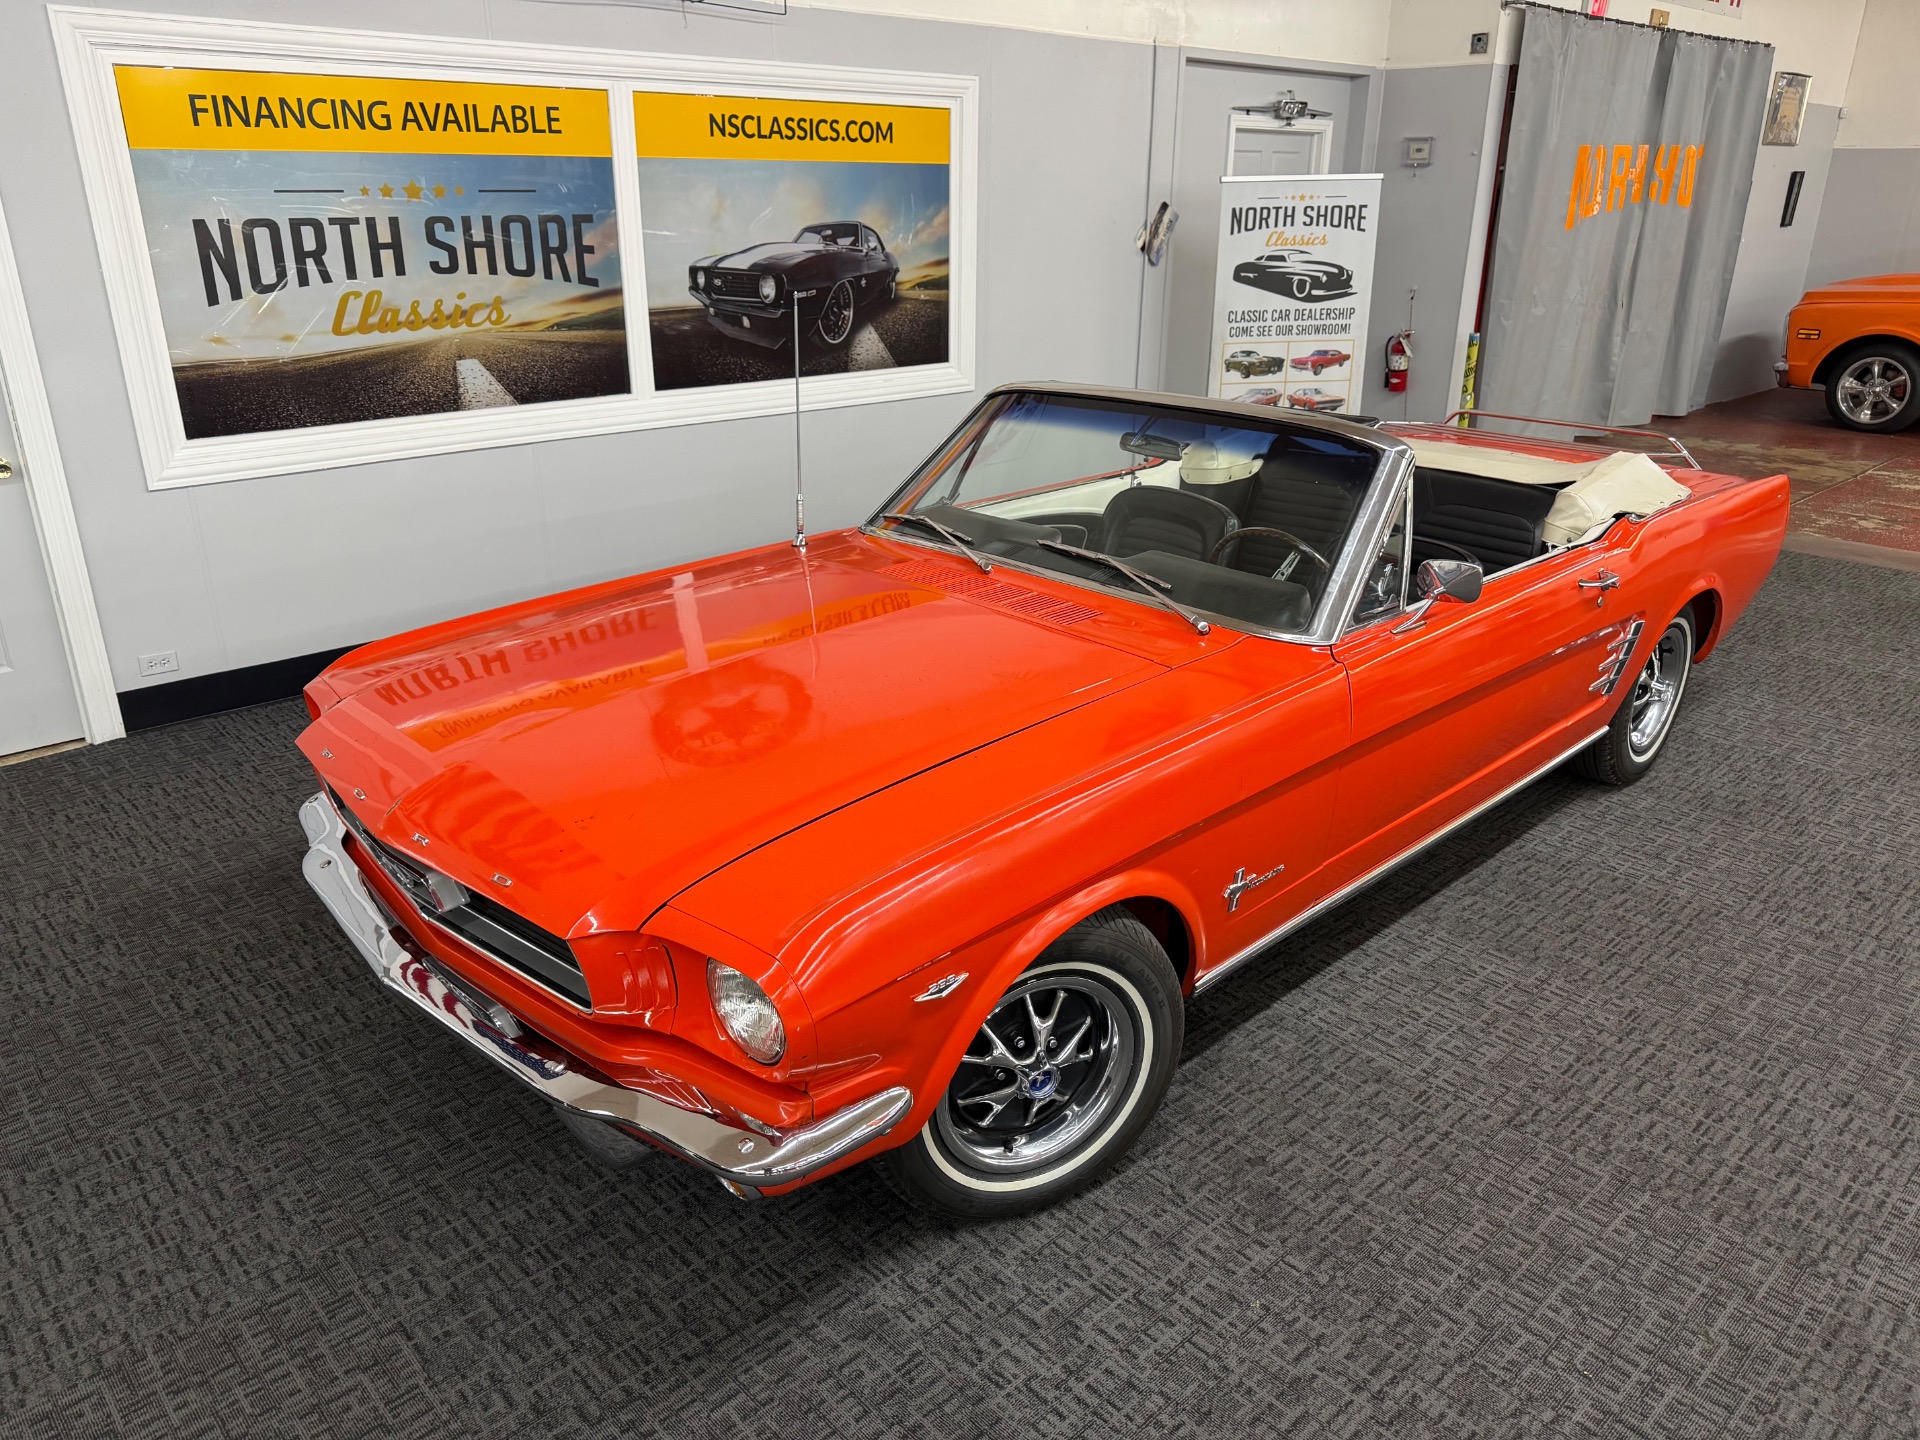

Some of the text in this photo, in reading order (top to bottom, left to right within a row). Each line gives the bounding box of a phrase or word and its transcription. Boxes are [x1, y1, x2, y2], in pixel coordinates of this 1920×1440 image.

[188, 93, 562, 134] FINANCING AVAILABLE
[708, 112, 894, 144] NSCLASSICS.COM
[1230, 204, 1368, 236] NORTH SHORE
[1265, 230, 1329, 247] Classics
[192, 213, 600, 307] NORTH SHORE
[332, 290, 512, 337] Classics
[1227, 307, 1356, 324] CLASSIC CAR DEALERSHIP
[1229, 323, 1351, 338] COME SEE OUR SHOWROOM!
